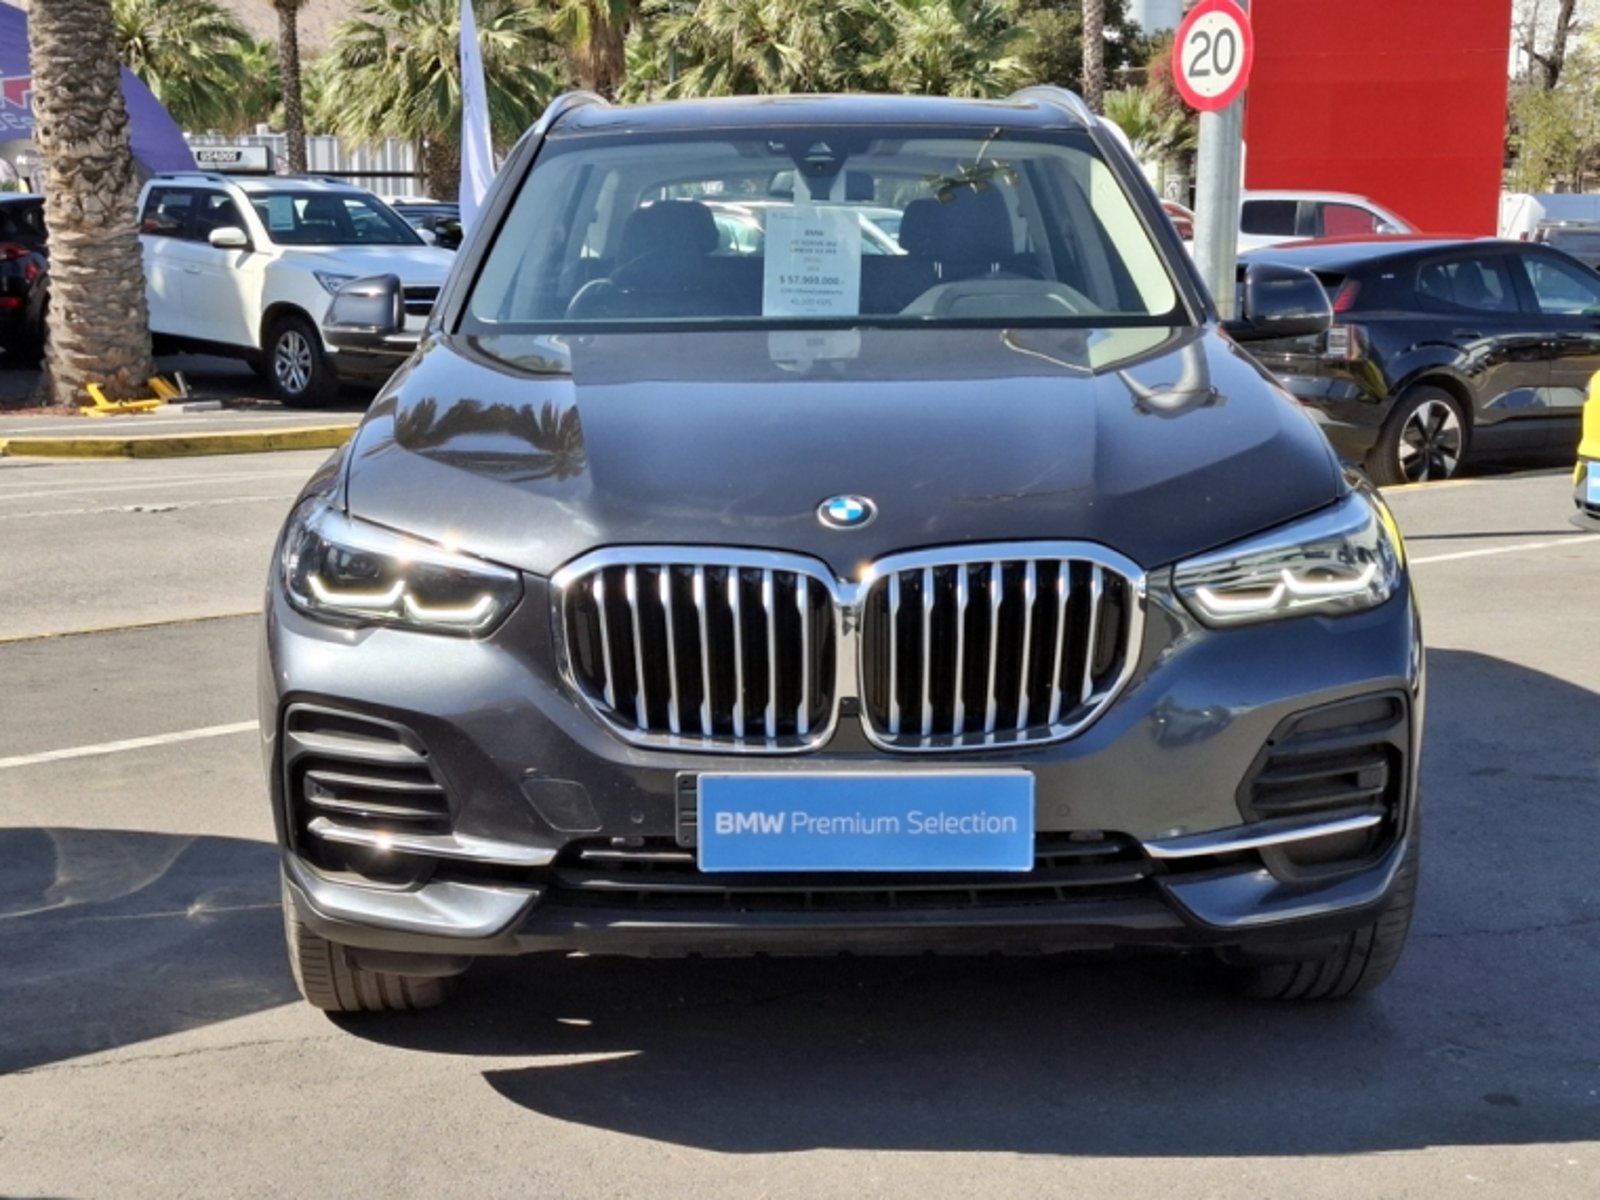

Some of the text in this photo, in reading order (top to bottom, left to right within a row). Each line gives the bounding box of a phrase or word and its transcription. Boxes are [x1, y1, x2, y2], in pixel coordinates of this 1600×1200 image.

[1188, 27, 1236, 77] 20
[714, 810, 1018, 835] BMW Premium Selection
